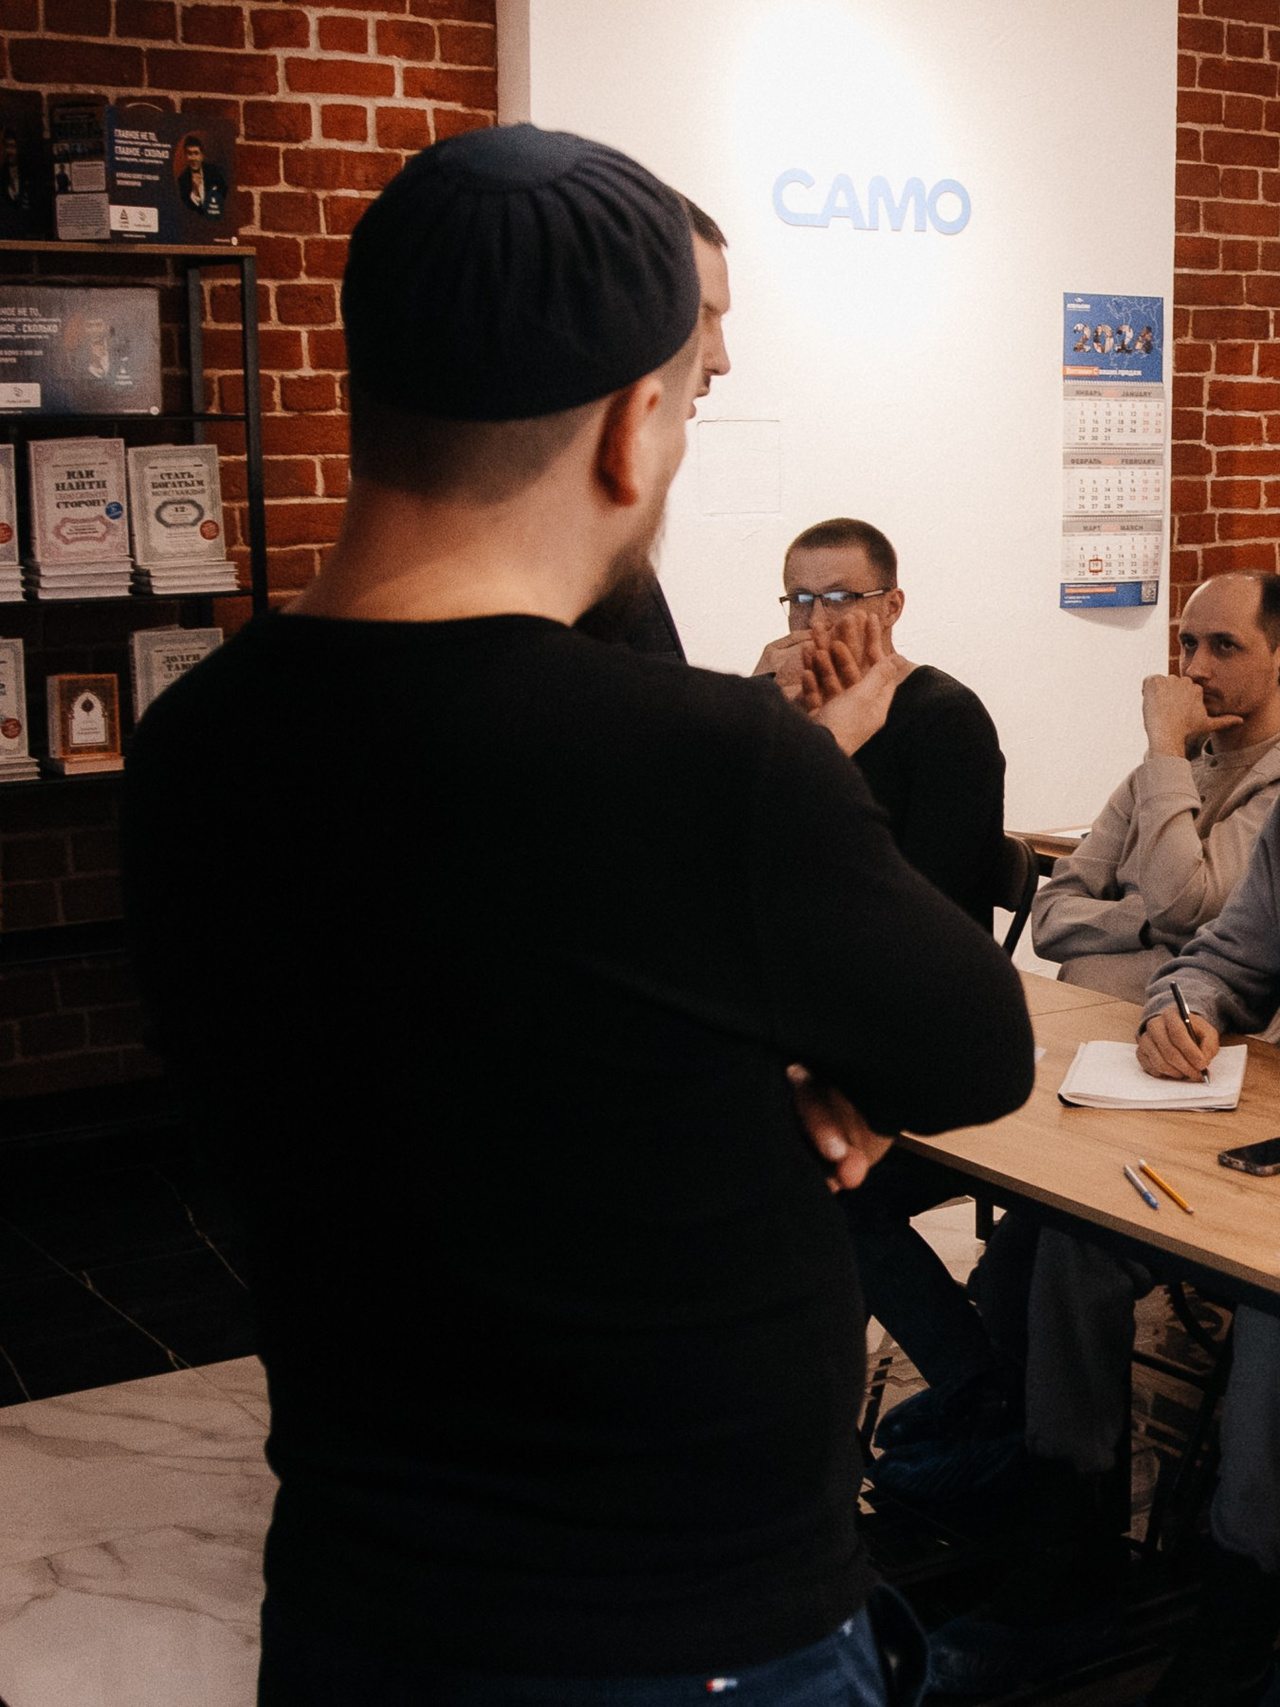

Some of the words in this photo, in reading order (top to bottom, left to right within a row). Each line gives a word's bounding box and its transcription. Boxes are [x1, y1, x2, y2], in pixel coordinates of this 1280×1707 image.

[772, 168, 972, 235] САМО
[1073, 323, 1154, 354] 2024
[66, 470, 95, 480] КАК
[160, 472, 194, 480] СТАТЬ
[151, 480, 205, 489] БОГАТЫМ
[56, 499, 107, 509] СТОРОНУ
